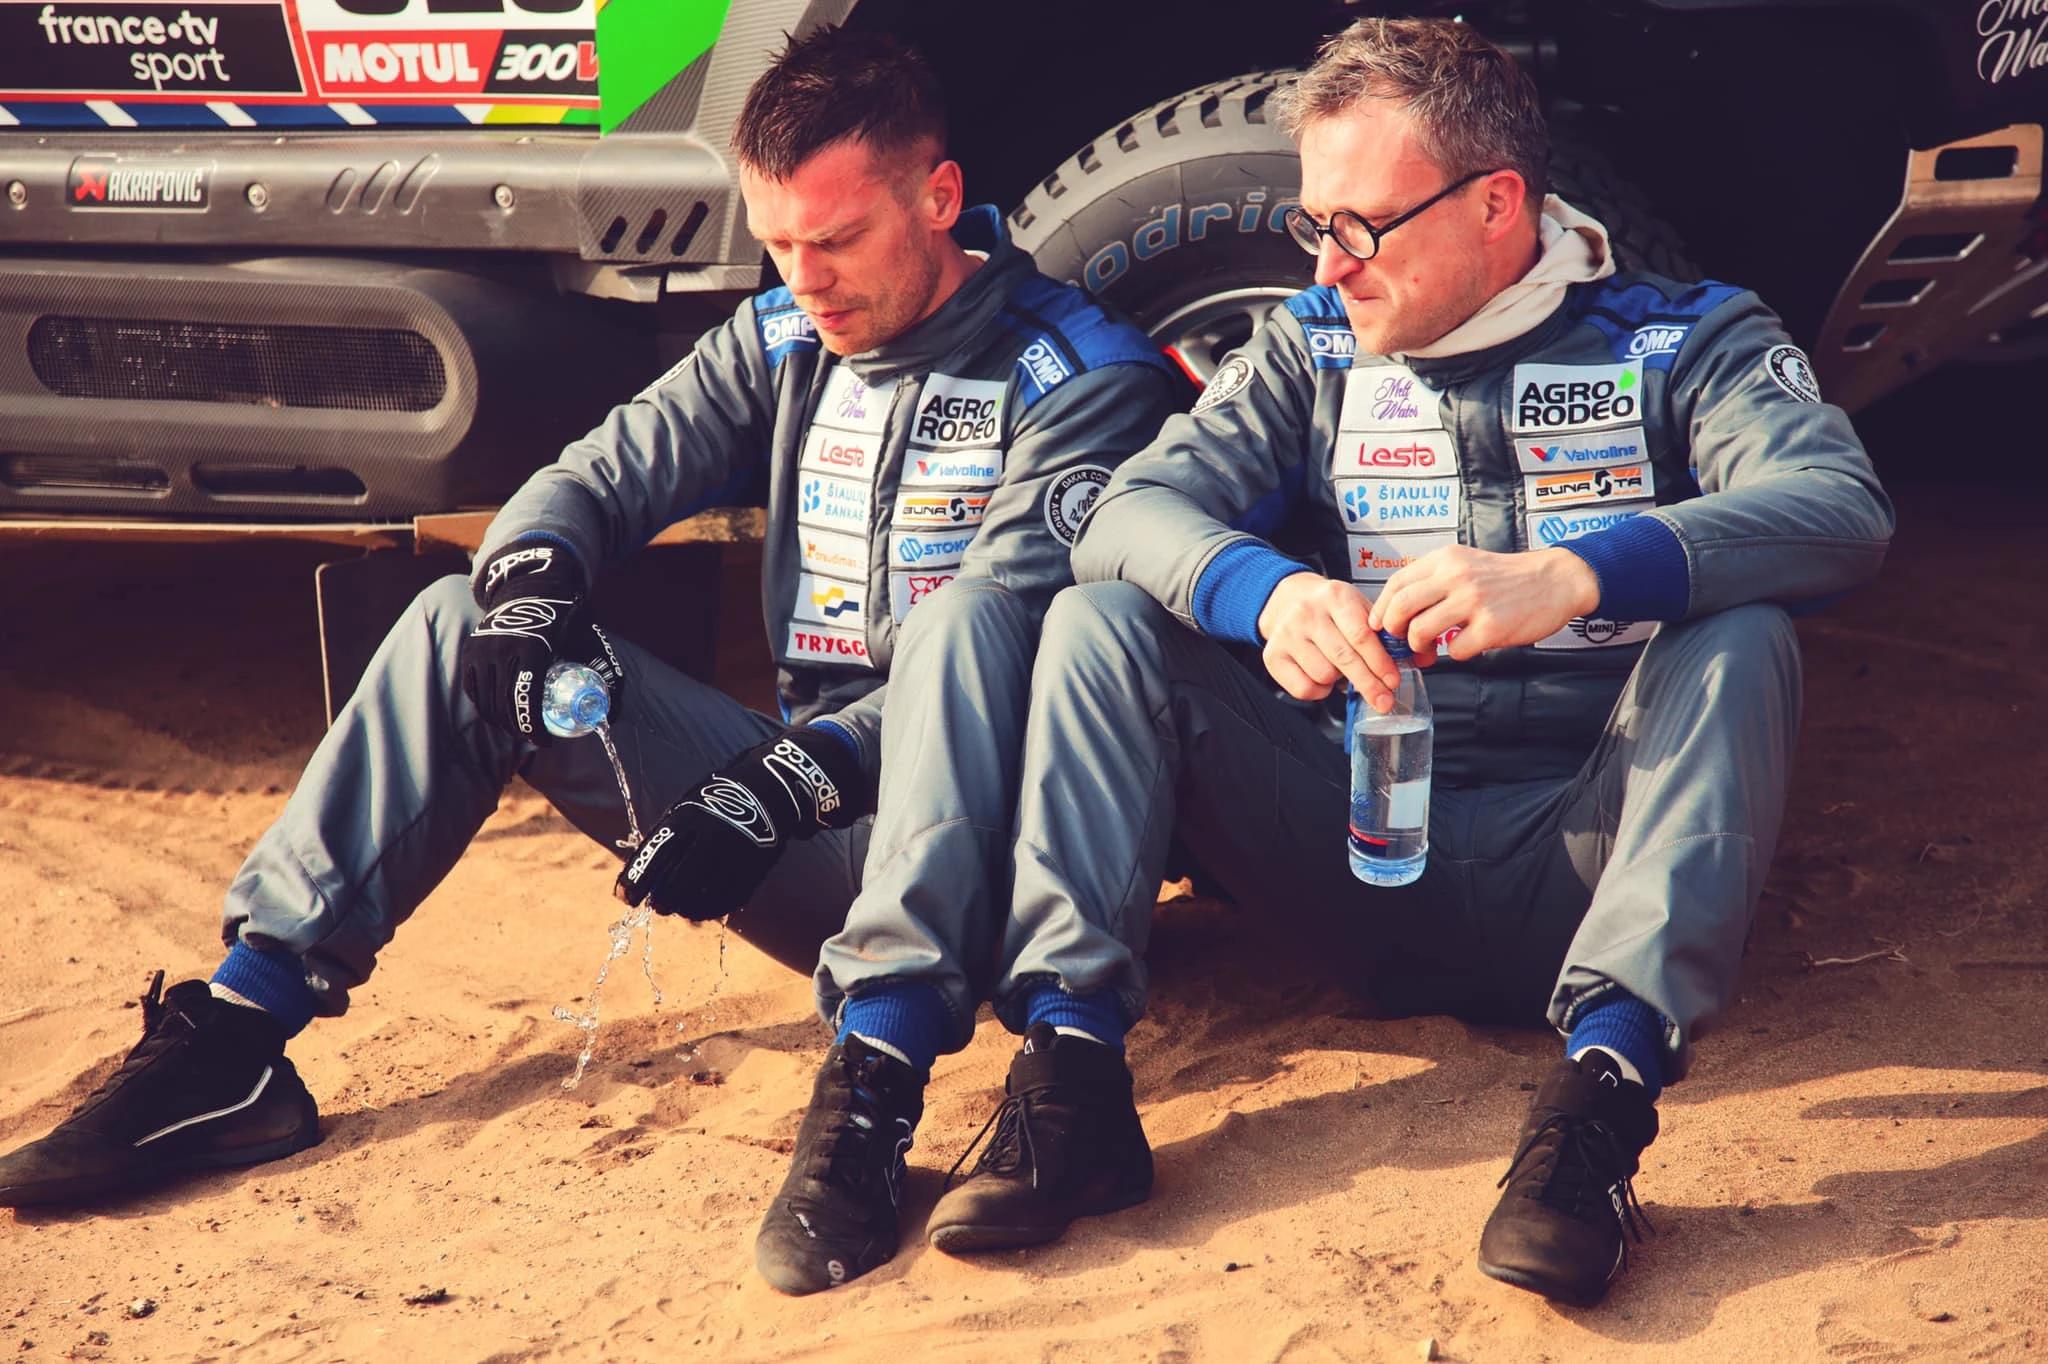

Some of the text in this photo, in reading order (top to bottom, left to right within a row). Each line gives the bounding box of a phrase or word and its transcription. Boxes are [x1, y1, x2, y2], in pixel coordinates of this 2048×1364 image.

[130, 46, 230, 91] sport
[323, 42, 479, 83] MOTUL
[763, 314, 816, 345] OMP
[1629, 329, 1684, 355] OMP
[1310, 333, 1354, 355] OM
[1022, 343, 1064, 385] OMP
[1518, 380, 1616, 405] AGRO
[921, 394, 997, 420] AGRO
[1518, 395, 1635, 428] RODEO
[916, 415, 996, 442] RODEO
[819, 438, 865, 468] Lesta
[1358, 441, 1436, 468] Lesta
[1563, 445, 1639, 463] Valvoline
[939, 463, 996, 478] Valvoline
[1061, 471, 1089, 489] DAKAR
[1378, 484, 1451, 501] ŠIAULIŲ
[825, 503, 865, 521] BANKAS
[1378, 503, 1450, 520] BANKAS
[1587, 623, 1614, 635] MINI
[794, 632, 868, 656] TRYGG
[514, 669, 534, 734] sparco
[773, 738, 841, 813] sparco
[627, 826, 675, 884] sparco
